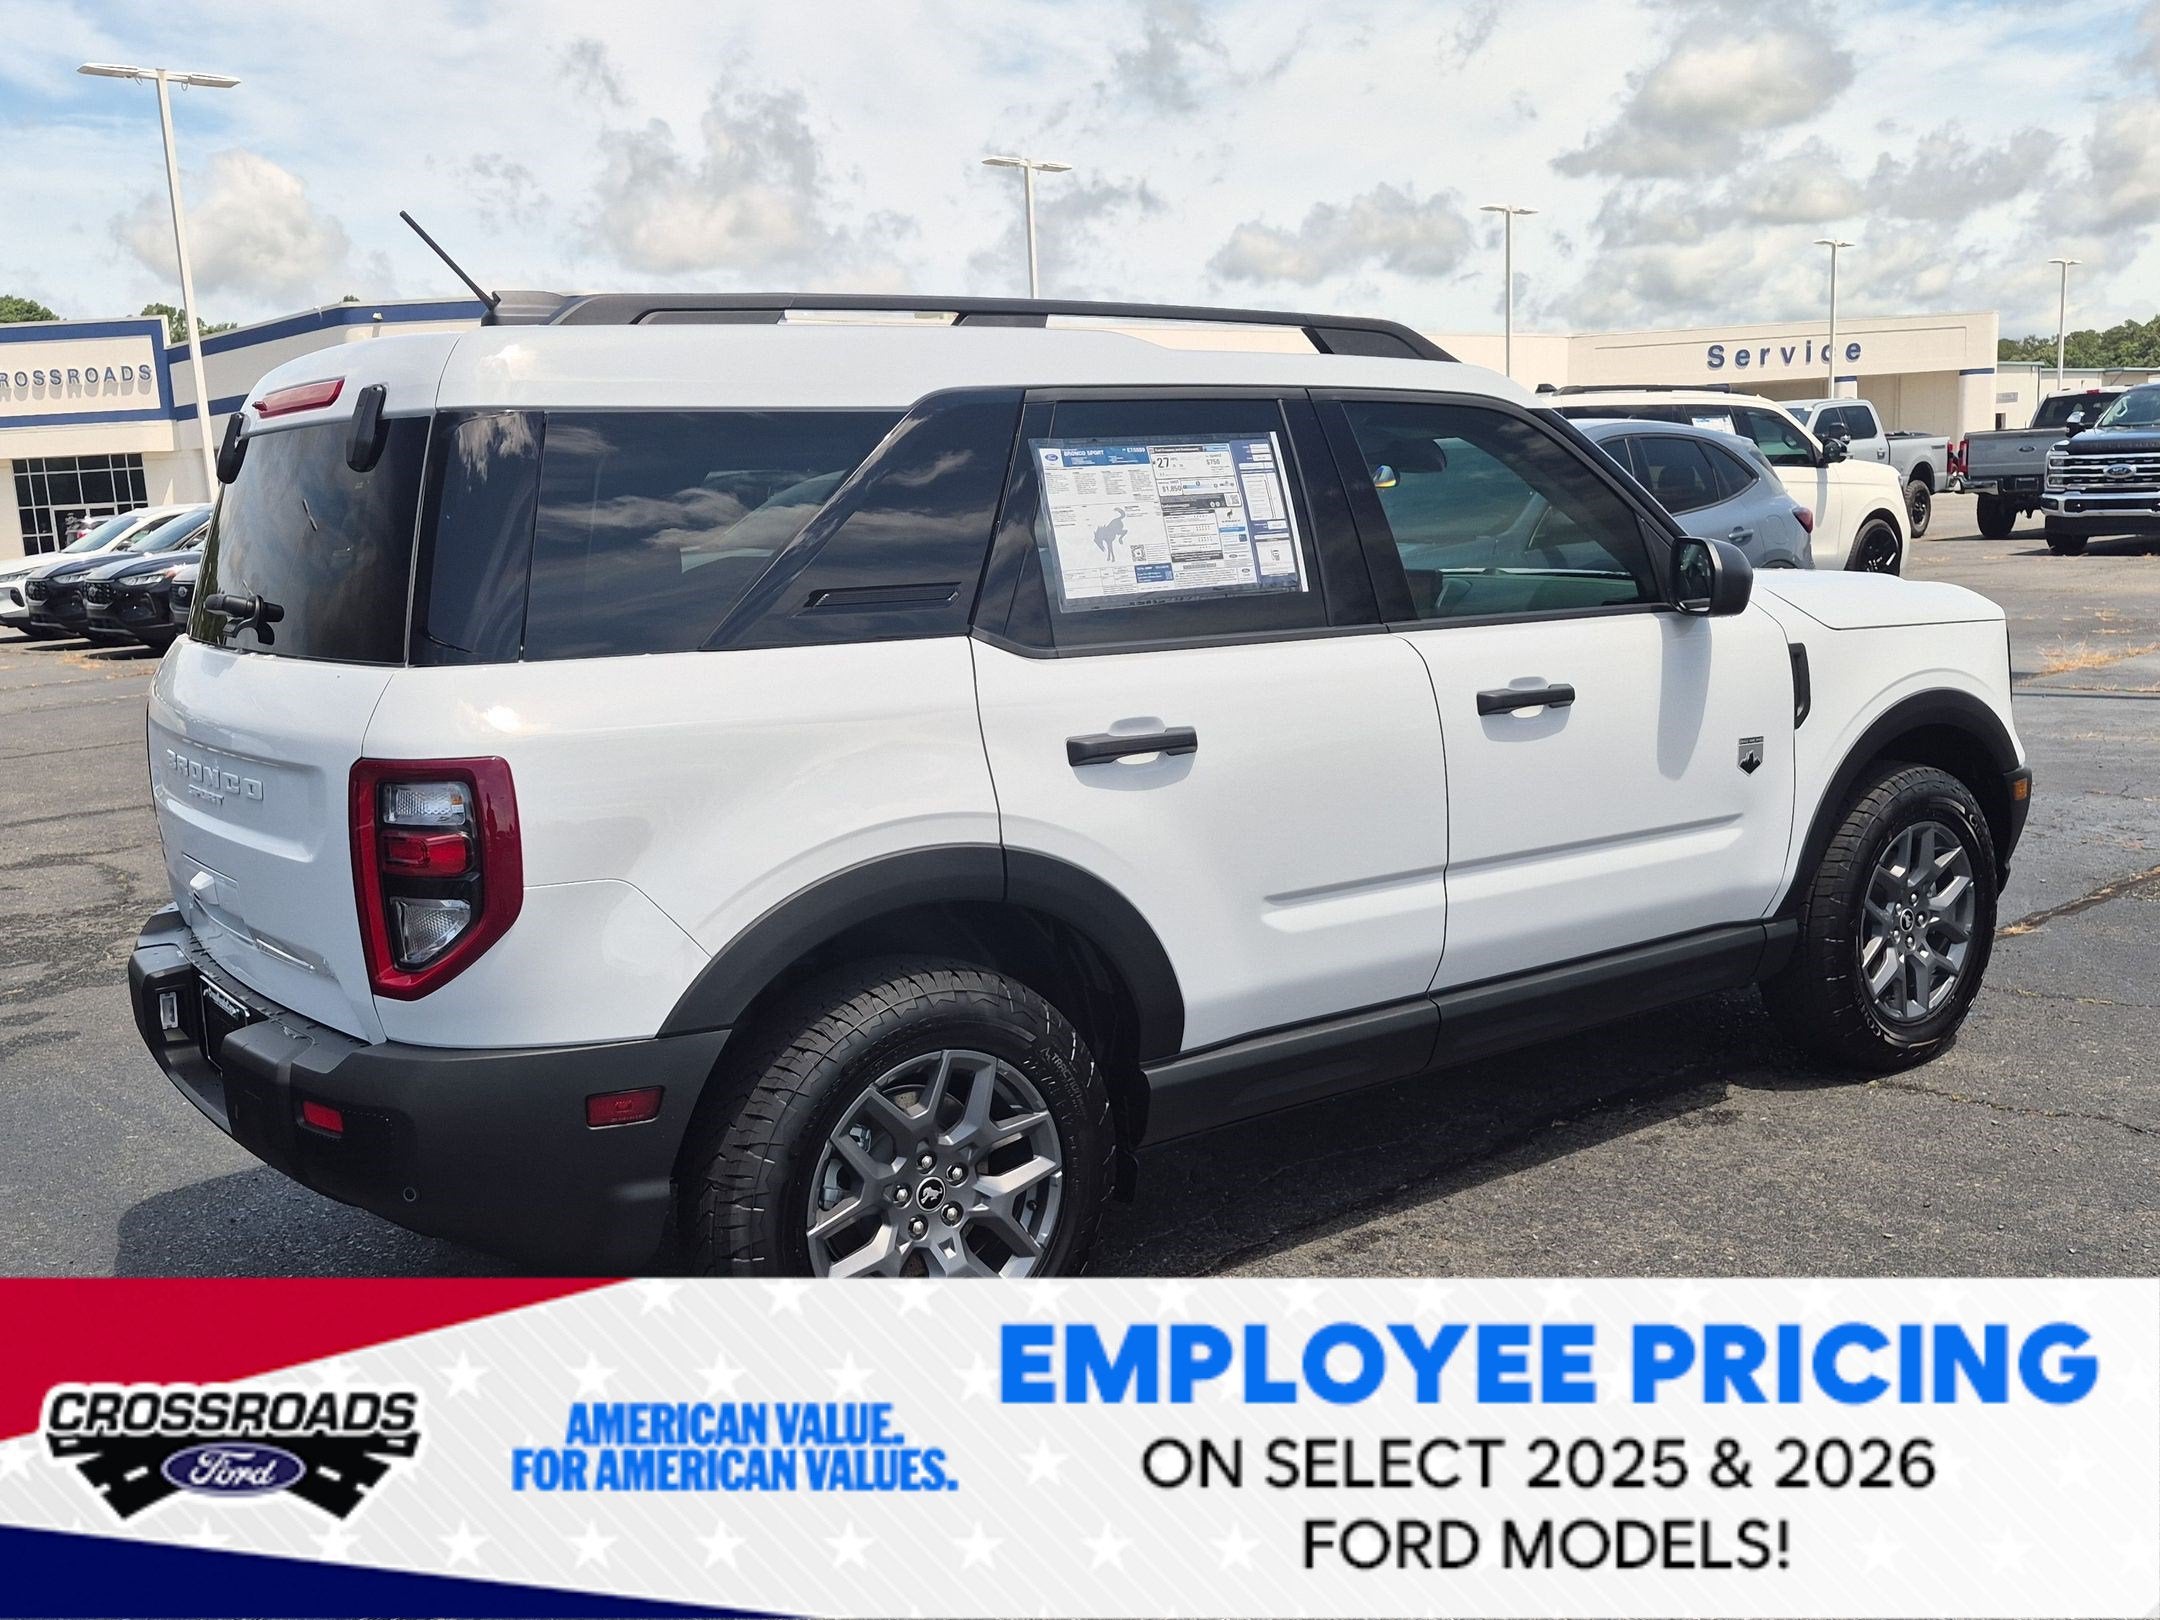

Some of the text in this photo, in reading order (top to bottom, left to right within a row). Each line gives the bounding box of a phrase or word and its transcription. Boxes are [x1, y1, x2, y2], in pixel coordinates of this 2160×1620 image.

[1707, 340, 1861, 368] Service
[1156, 456, 1170, 469] 27
[166, 748, 264, 801] BRONCO
